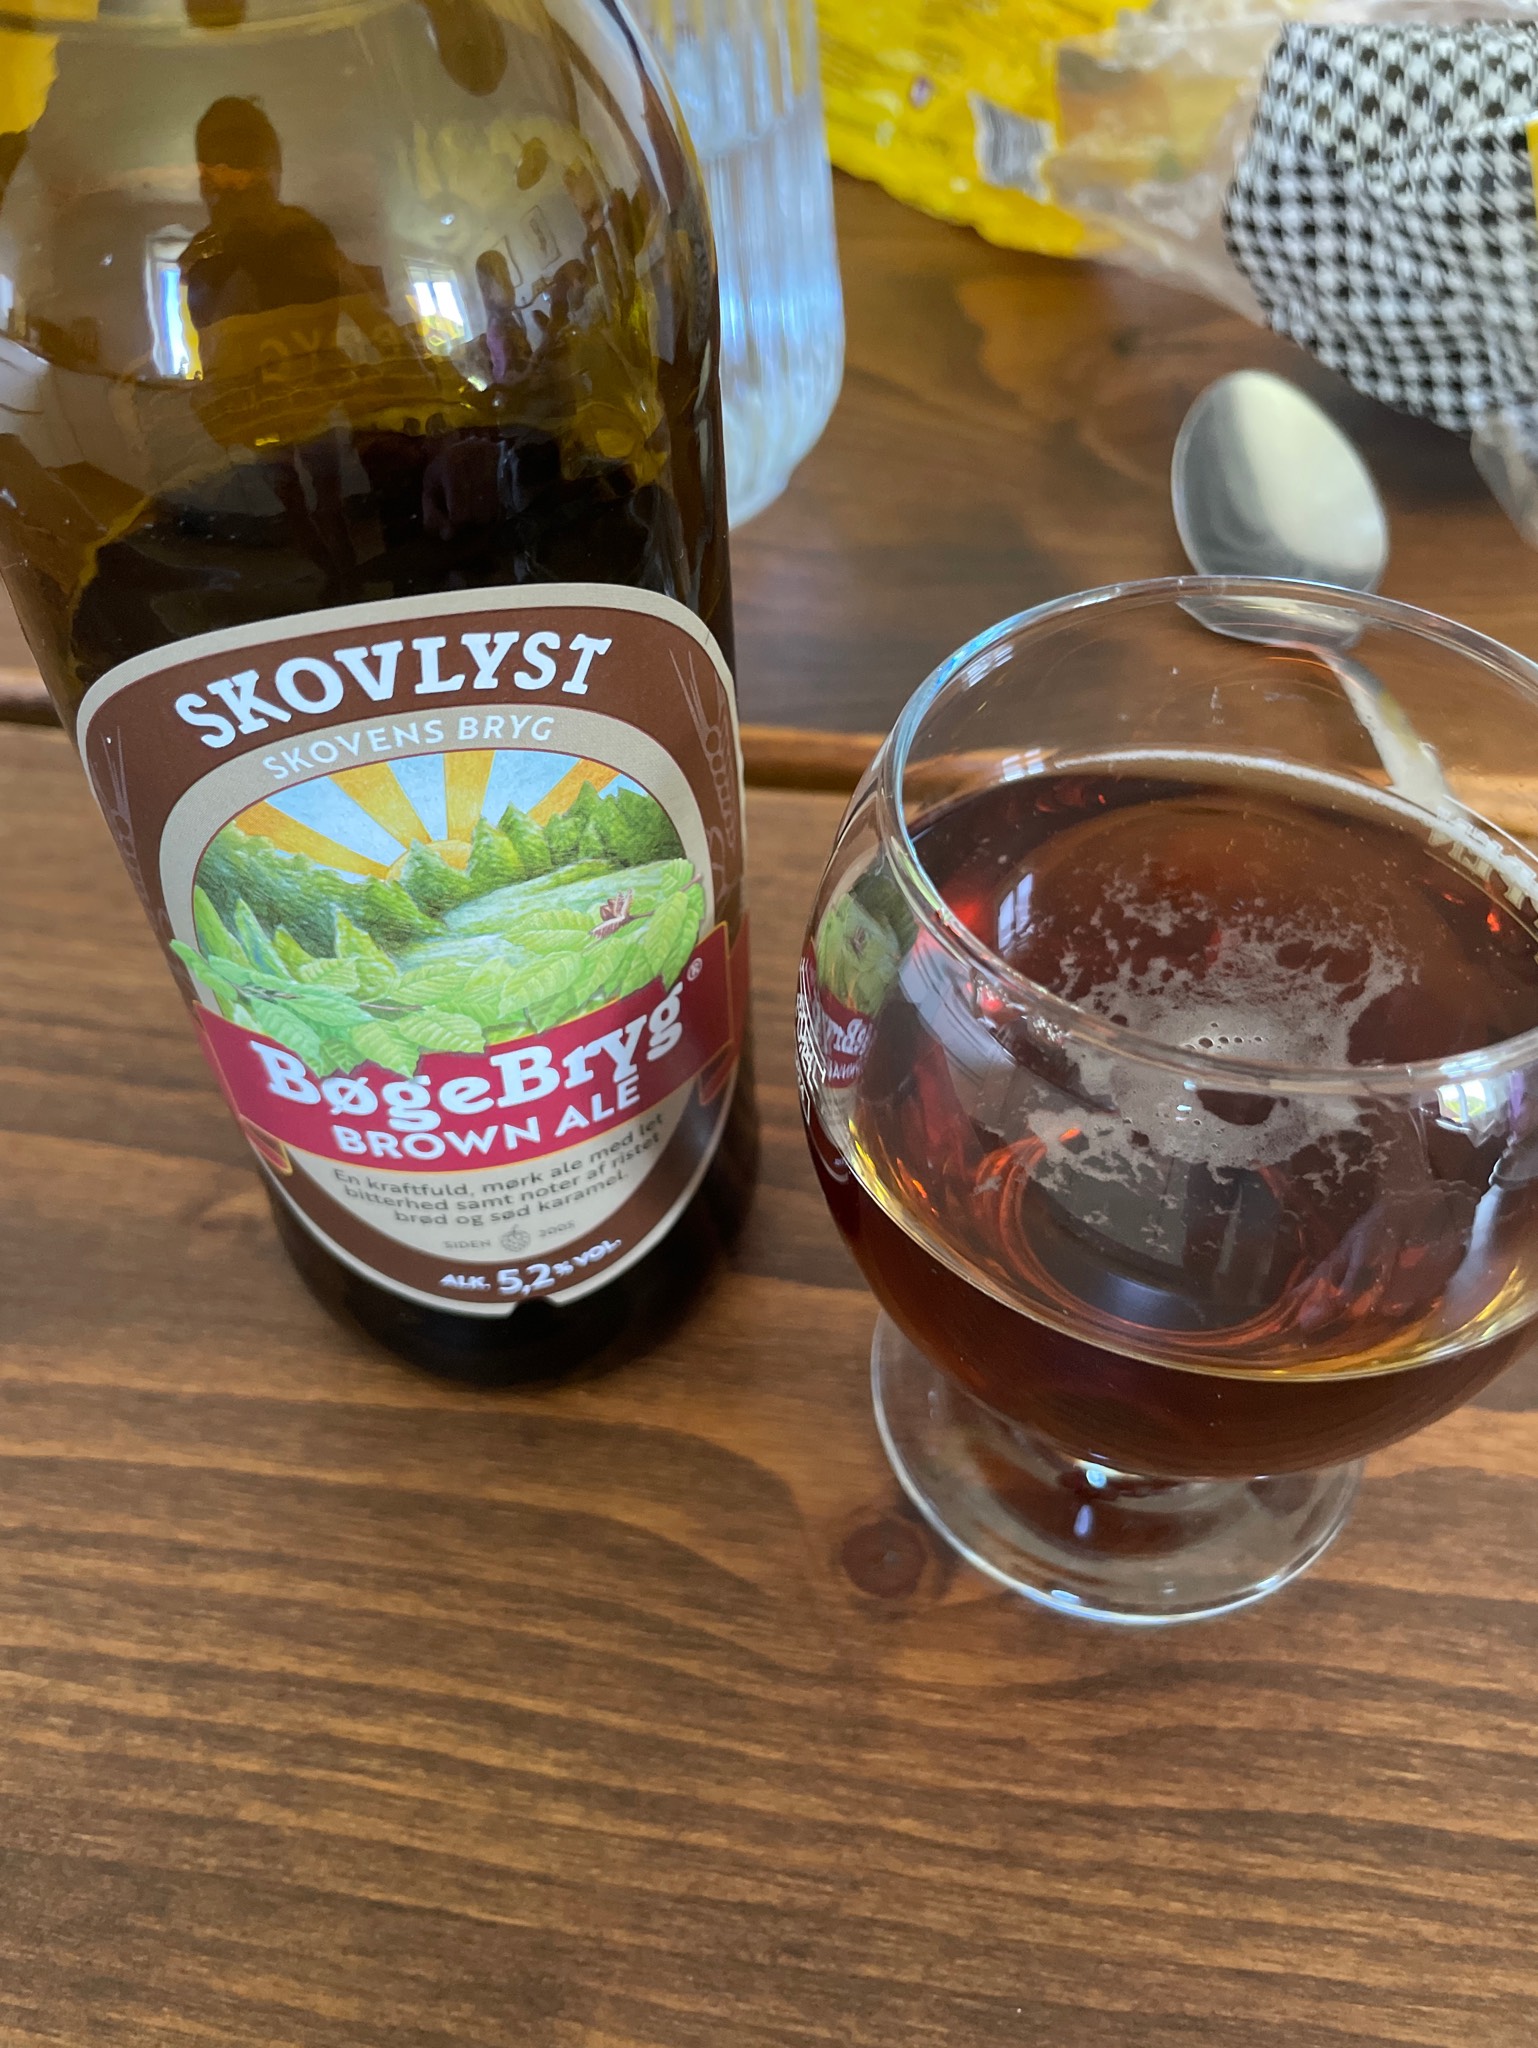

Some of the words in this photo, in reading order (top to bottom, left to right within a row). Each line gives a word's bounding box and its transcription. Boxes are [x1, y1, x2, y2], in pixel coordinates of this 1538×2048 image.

[174, 631, 612, 748] SKOVLYST
[262, 719, 444, 780] SKOVENS
[457, 714, 555, 741] BRYG
[249, 982, 684, 1132] BøgeBryg
[331, 1115, 541, 1160] BROWN
[553, 1076, 640, 1138] ALE
[333, 1168, 361, 1186] En
[367, 1176, 475, 1198] kraftfuld,
[482, 1171, 543, 1194] mørk
[551, 1159, 583, 1178] ale
[589, 1131, 634, 1164] med
[638, 1113, 662, 1136] let
[344, 1184, 449, 1210] bitterhed
[457, 1193, 514, 1210] samt
[521, 1176, 580, 1202] noter
[586, 1163, 607, 1183] af
[612, 1132, 659, 1168] ristet
[394, 1210, 449, 1226] brød
[456, 1215, 484, 1227] og
[491, 1204, 531, 1223] sød
[443, 1239, 492, 1249] SIDEN
[438, 1273, 491, 1291] ALK.
